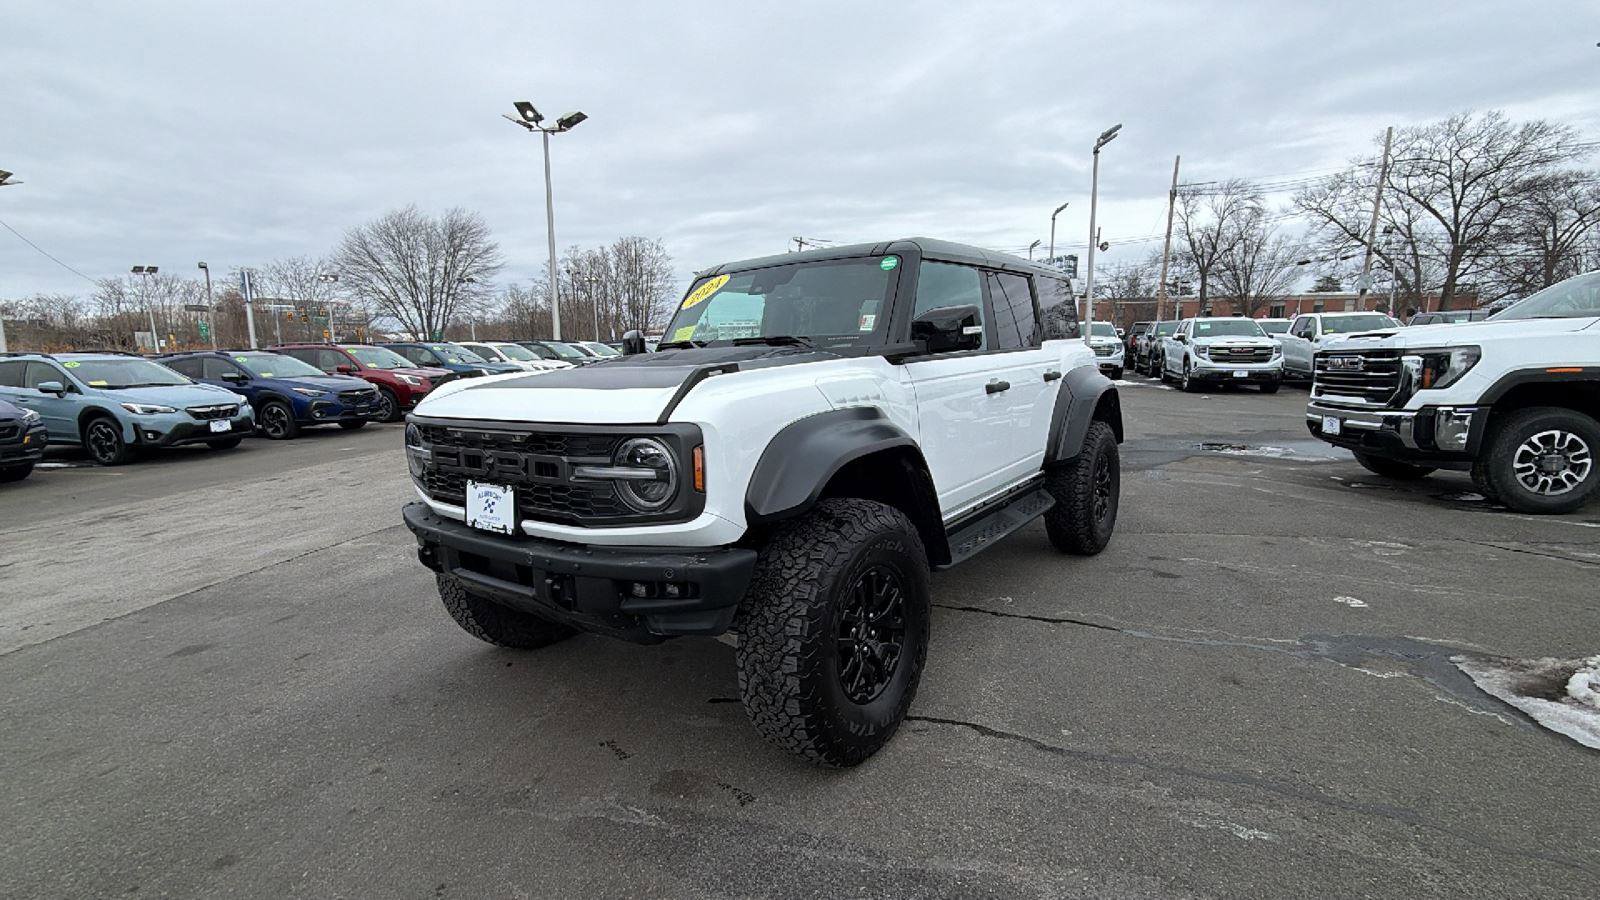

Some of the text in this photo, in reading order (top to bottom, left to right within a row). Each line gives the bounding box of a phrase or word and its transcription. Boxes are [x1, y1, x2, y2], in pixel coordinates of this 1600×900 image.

[687, 275, 725, 307] 2024
[1327, 357, 1358, 369] GMC
[432, 445, 570, 483] FORD
